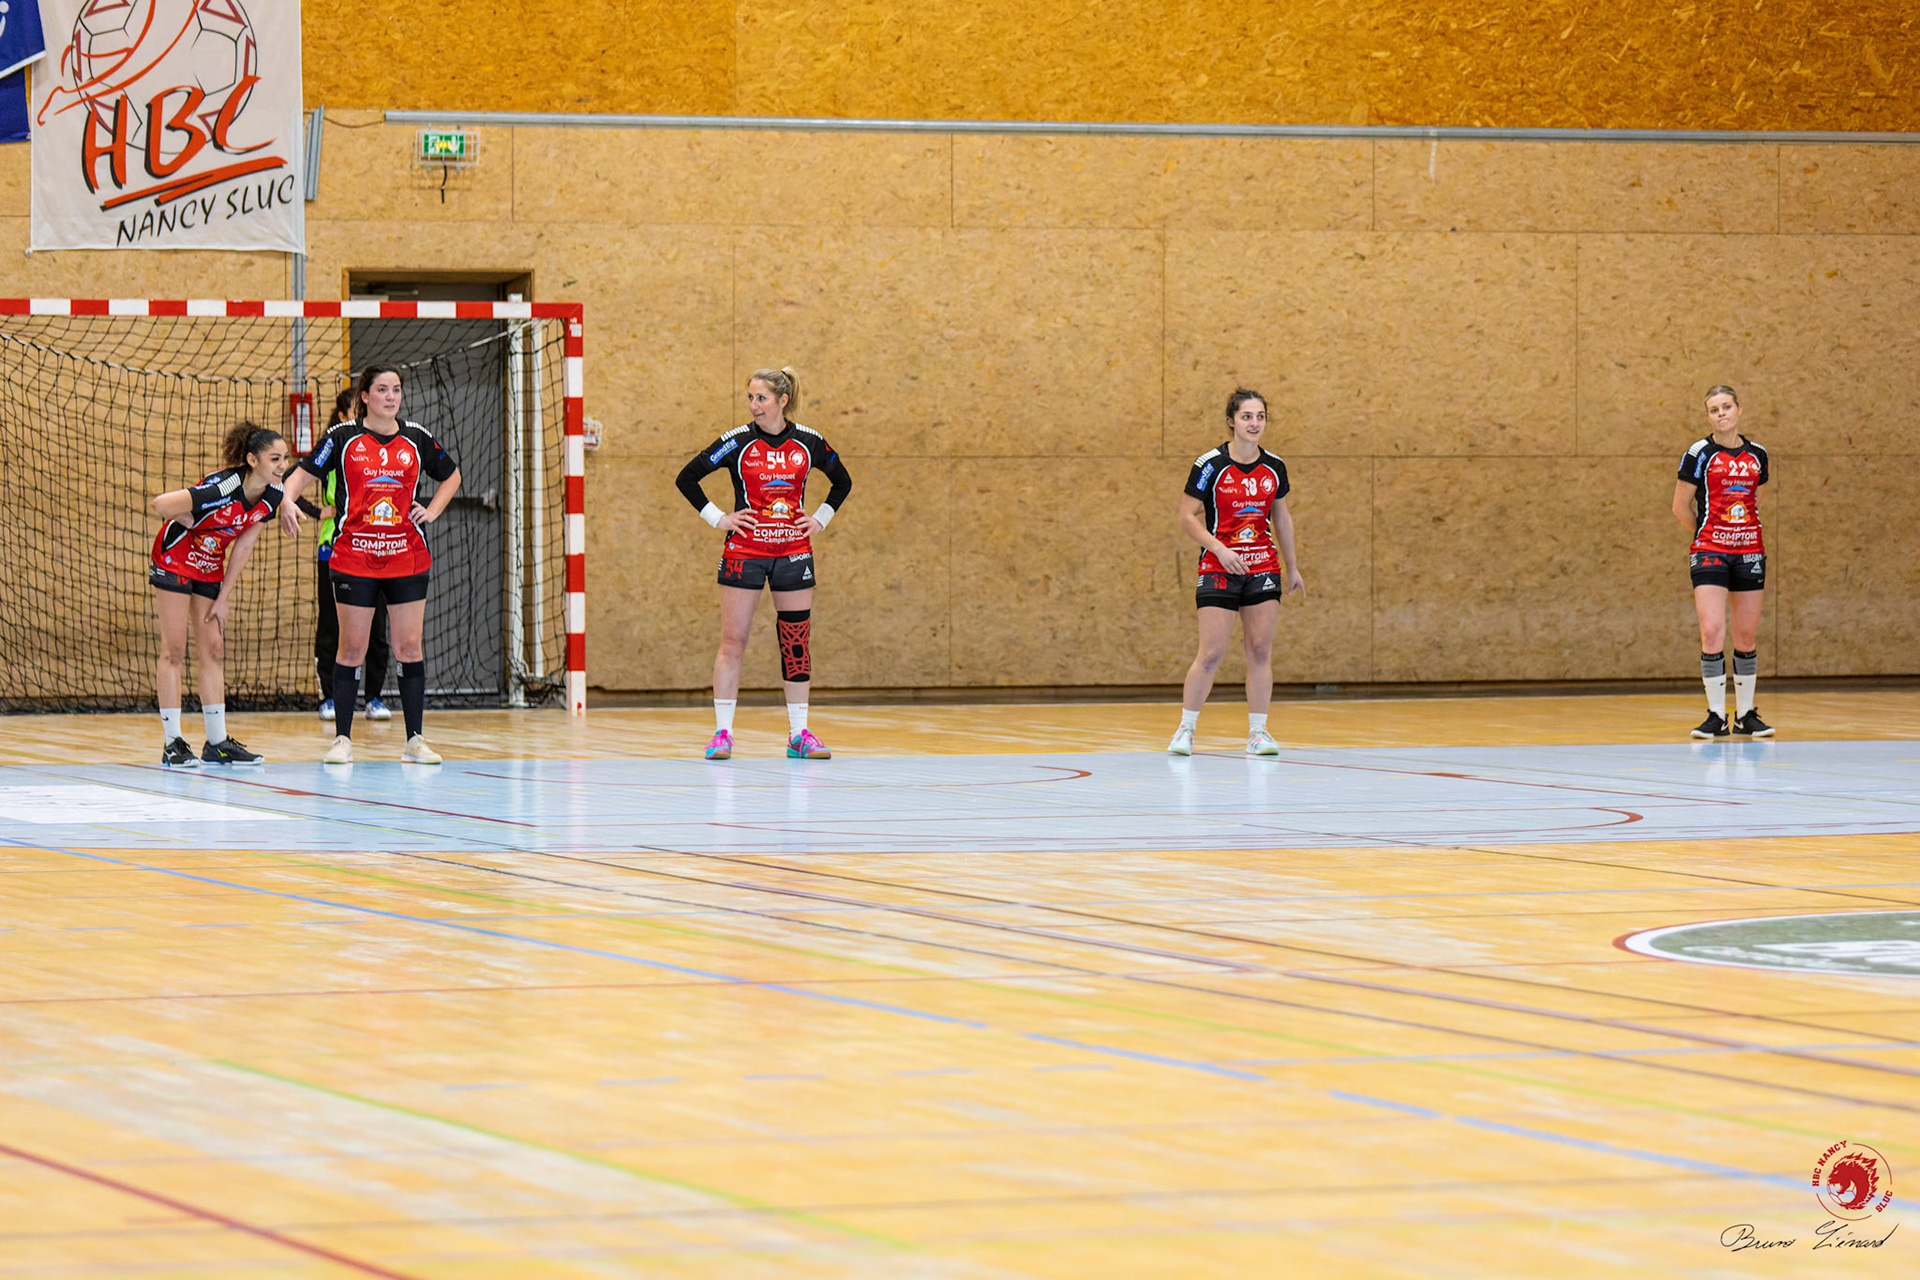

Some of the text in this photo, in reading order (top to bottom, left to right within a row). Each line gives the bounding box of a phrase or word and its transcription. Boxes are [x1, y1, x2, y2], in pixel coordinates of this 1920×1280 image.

[82, 75, 276, 194] HBC
[117, 175, 294, 247] NANCY SLUC
[766, 450, 786, 469] 54
[363, 467, 404, 477] Guy Hoquet
[759, 473, 795, 481] Guy Hoquet
[1728, 460, 1750, 477] 22
[1241, 477, 1257, 496] 18
[352, 538, 408, 550] COMPTOIR
[1712, 531, 1757, 541] COMPTOIR
[725, 559, 744, 580] 54
[1211, 574, 1227, 589] 18
